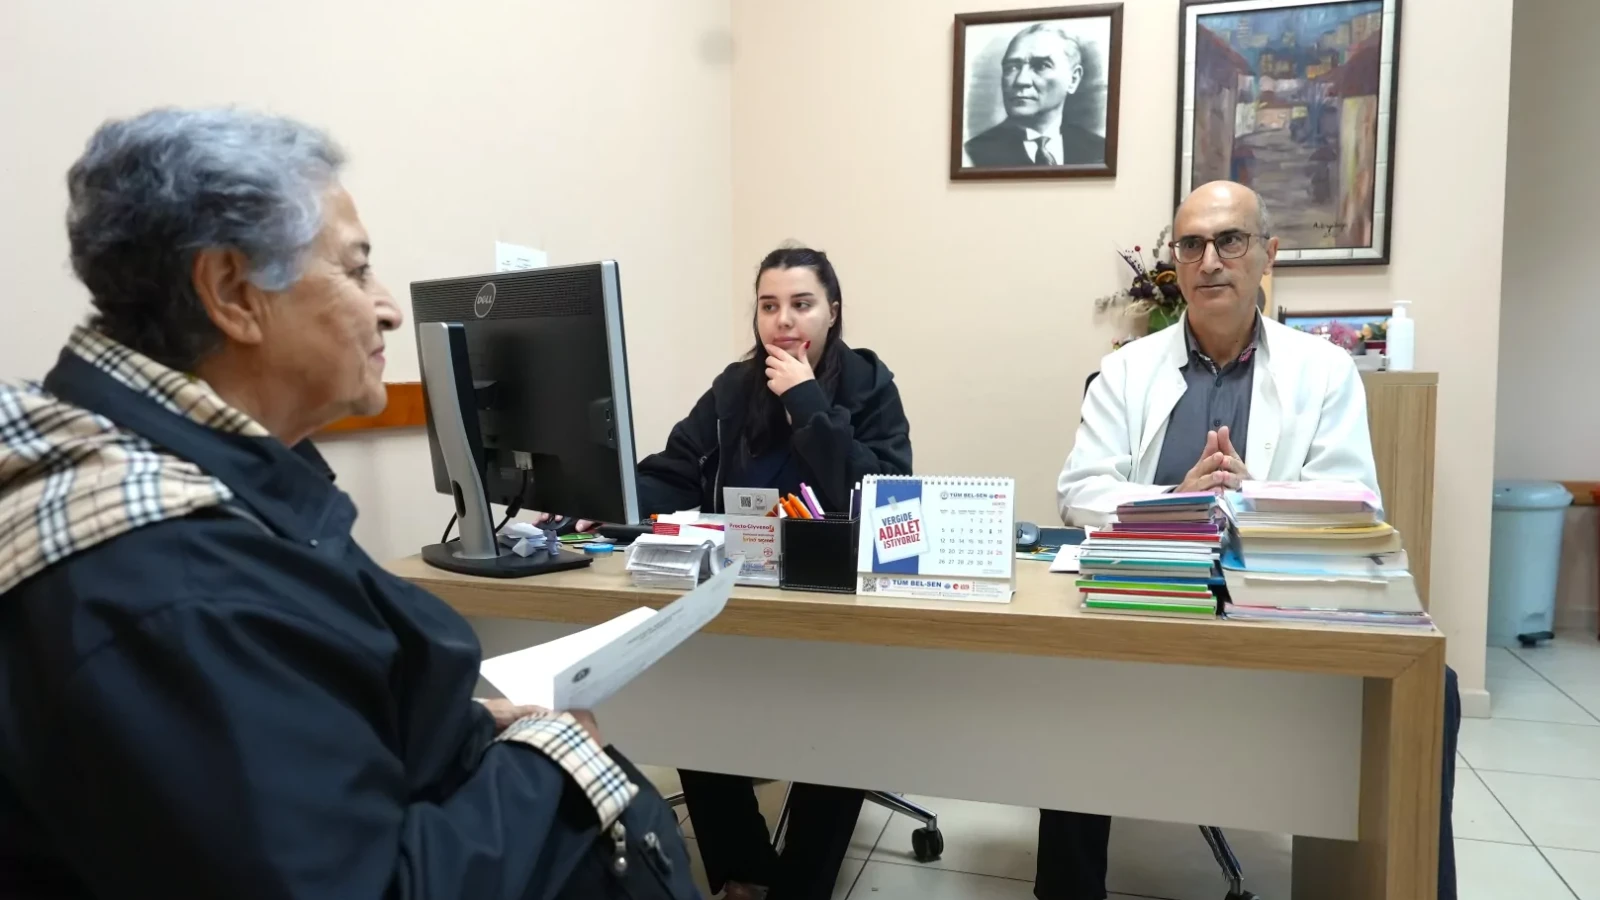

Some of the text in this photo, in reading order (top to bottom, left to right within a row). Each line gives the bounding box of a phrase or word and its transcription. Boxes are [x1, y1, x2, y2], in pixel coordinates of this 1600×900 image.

[477, 295, 492, 304] DELL
[879, 519, 921, 541] ADALET
[910, 580, 942, 588] BEL-SEN
